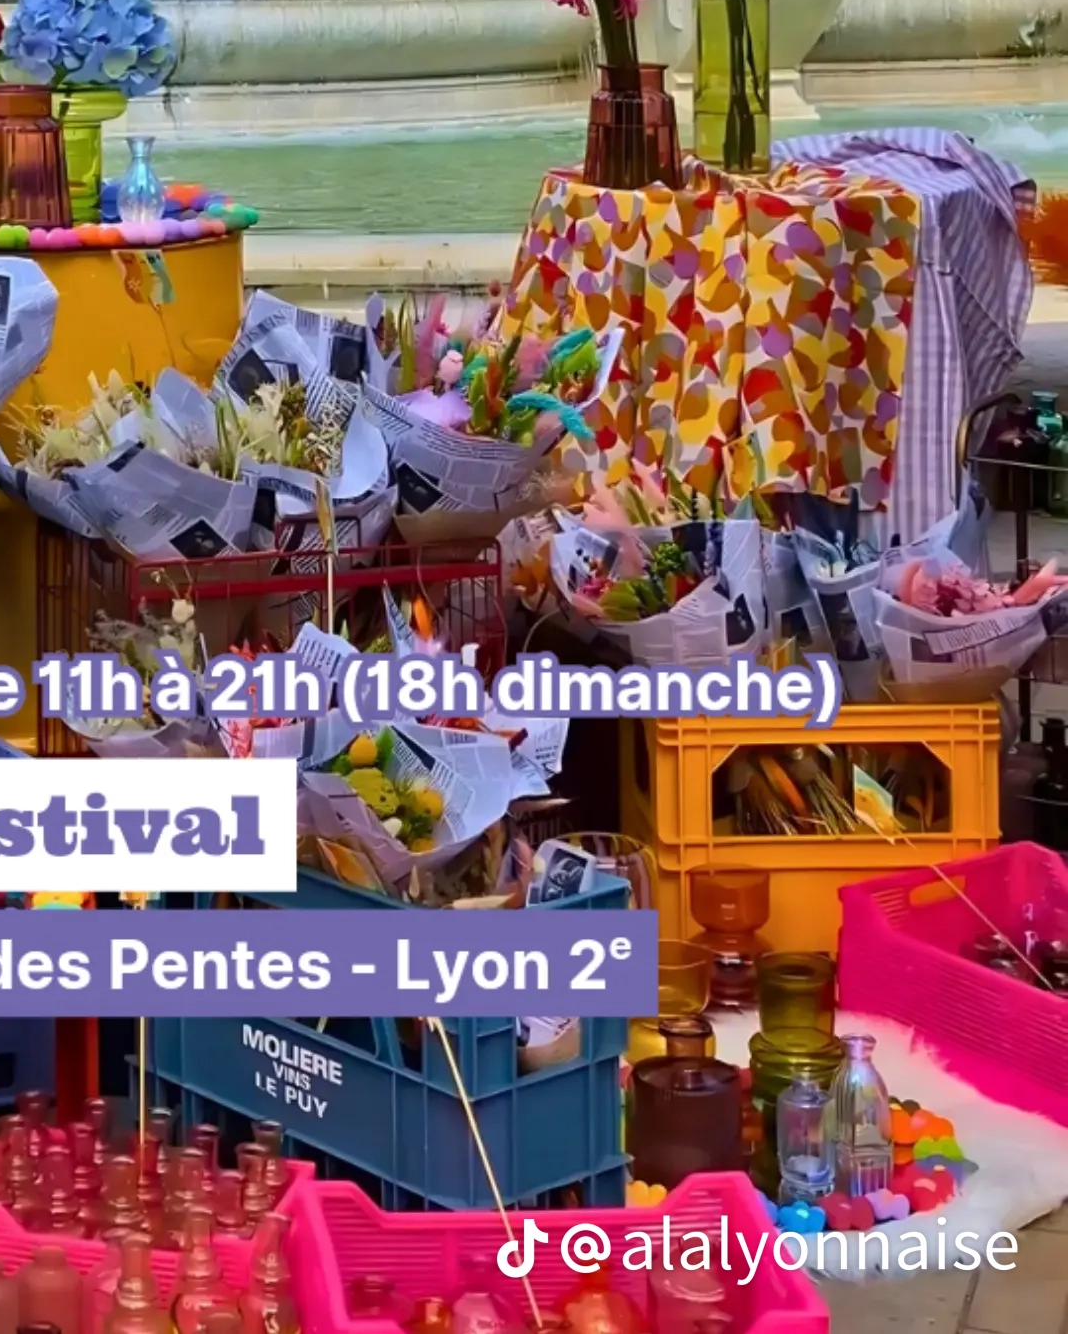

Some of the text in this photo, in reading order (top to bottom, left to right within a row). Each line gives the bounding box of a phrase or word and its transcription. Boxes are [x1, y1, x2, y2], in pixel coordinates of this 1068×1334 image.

[242, 1023, 343, 1086] MOLIERE
[272, 1060, 312, 1091] VINS
[255, 1070, 328, 1119] LE PUY
